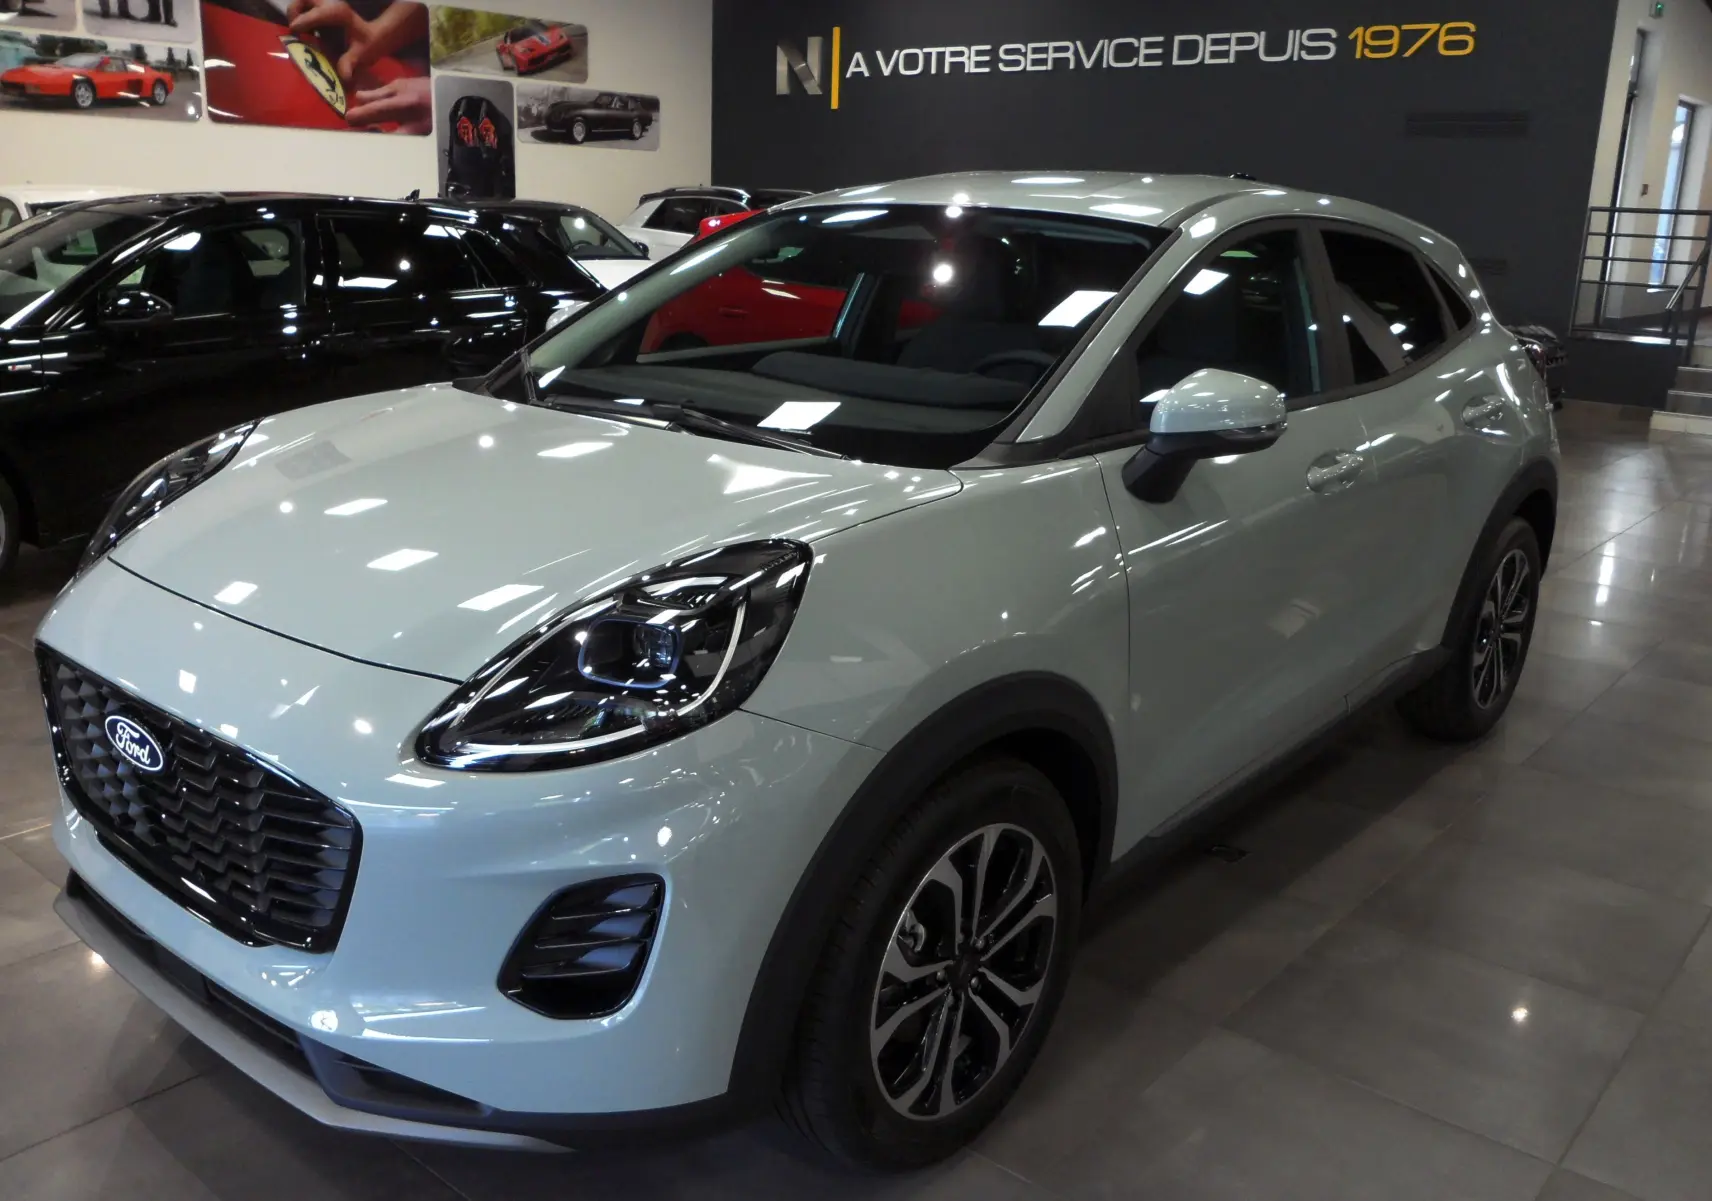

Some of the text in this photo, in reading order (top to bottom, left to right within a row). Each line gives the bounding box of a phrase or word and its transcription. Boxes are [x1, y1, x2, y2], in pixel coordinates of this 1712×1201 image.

[776, 37, 823, 95] N
[845, 21, 1477, 78] A VOTRE SERVICE DEPUIS 1976
[116, 721, 150, 765] Ford
